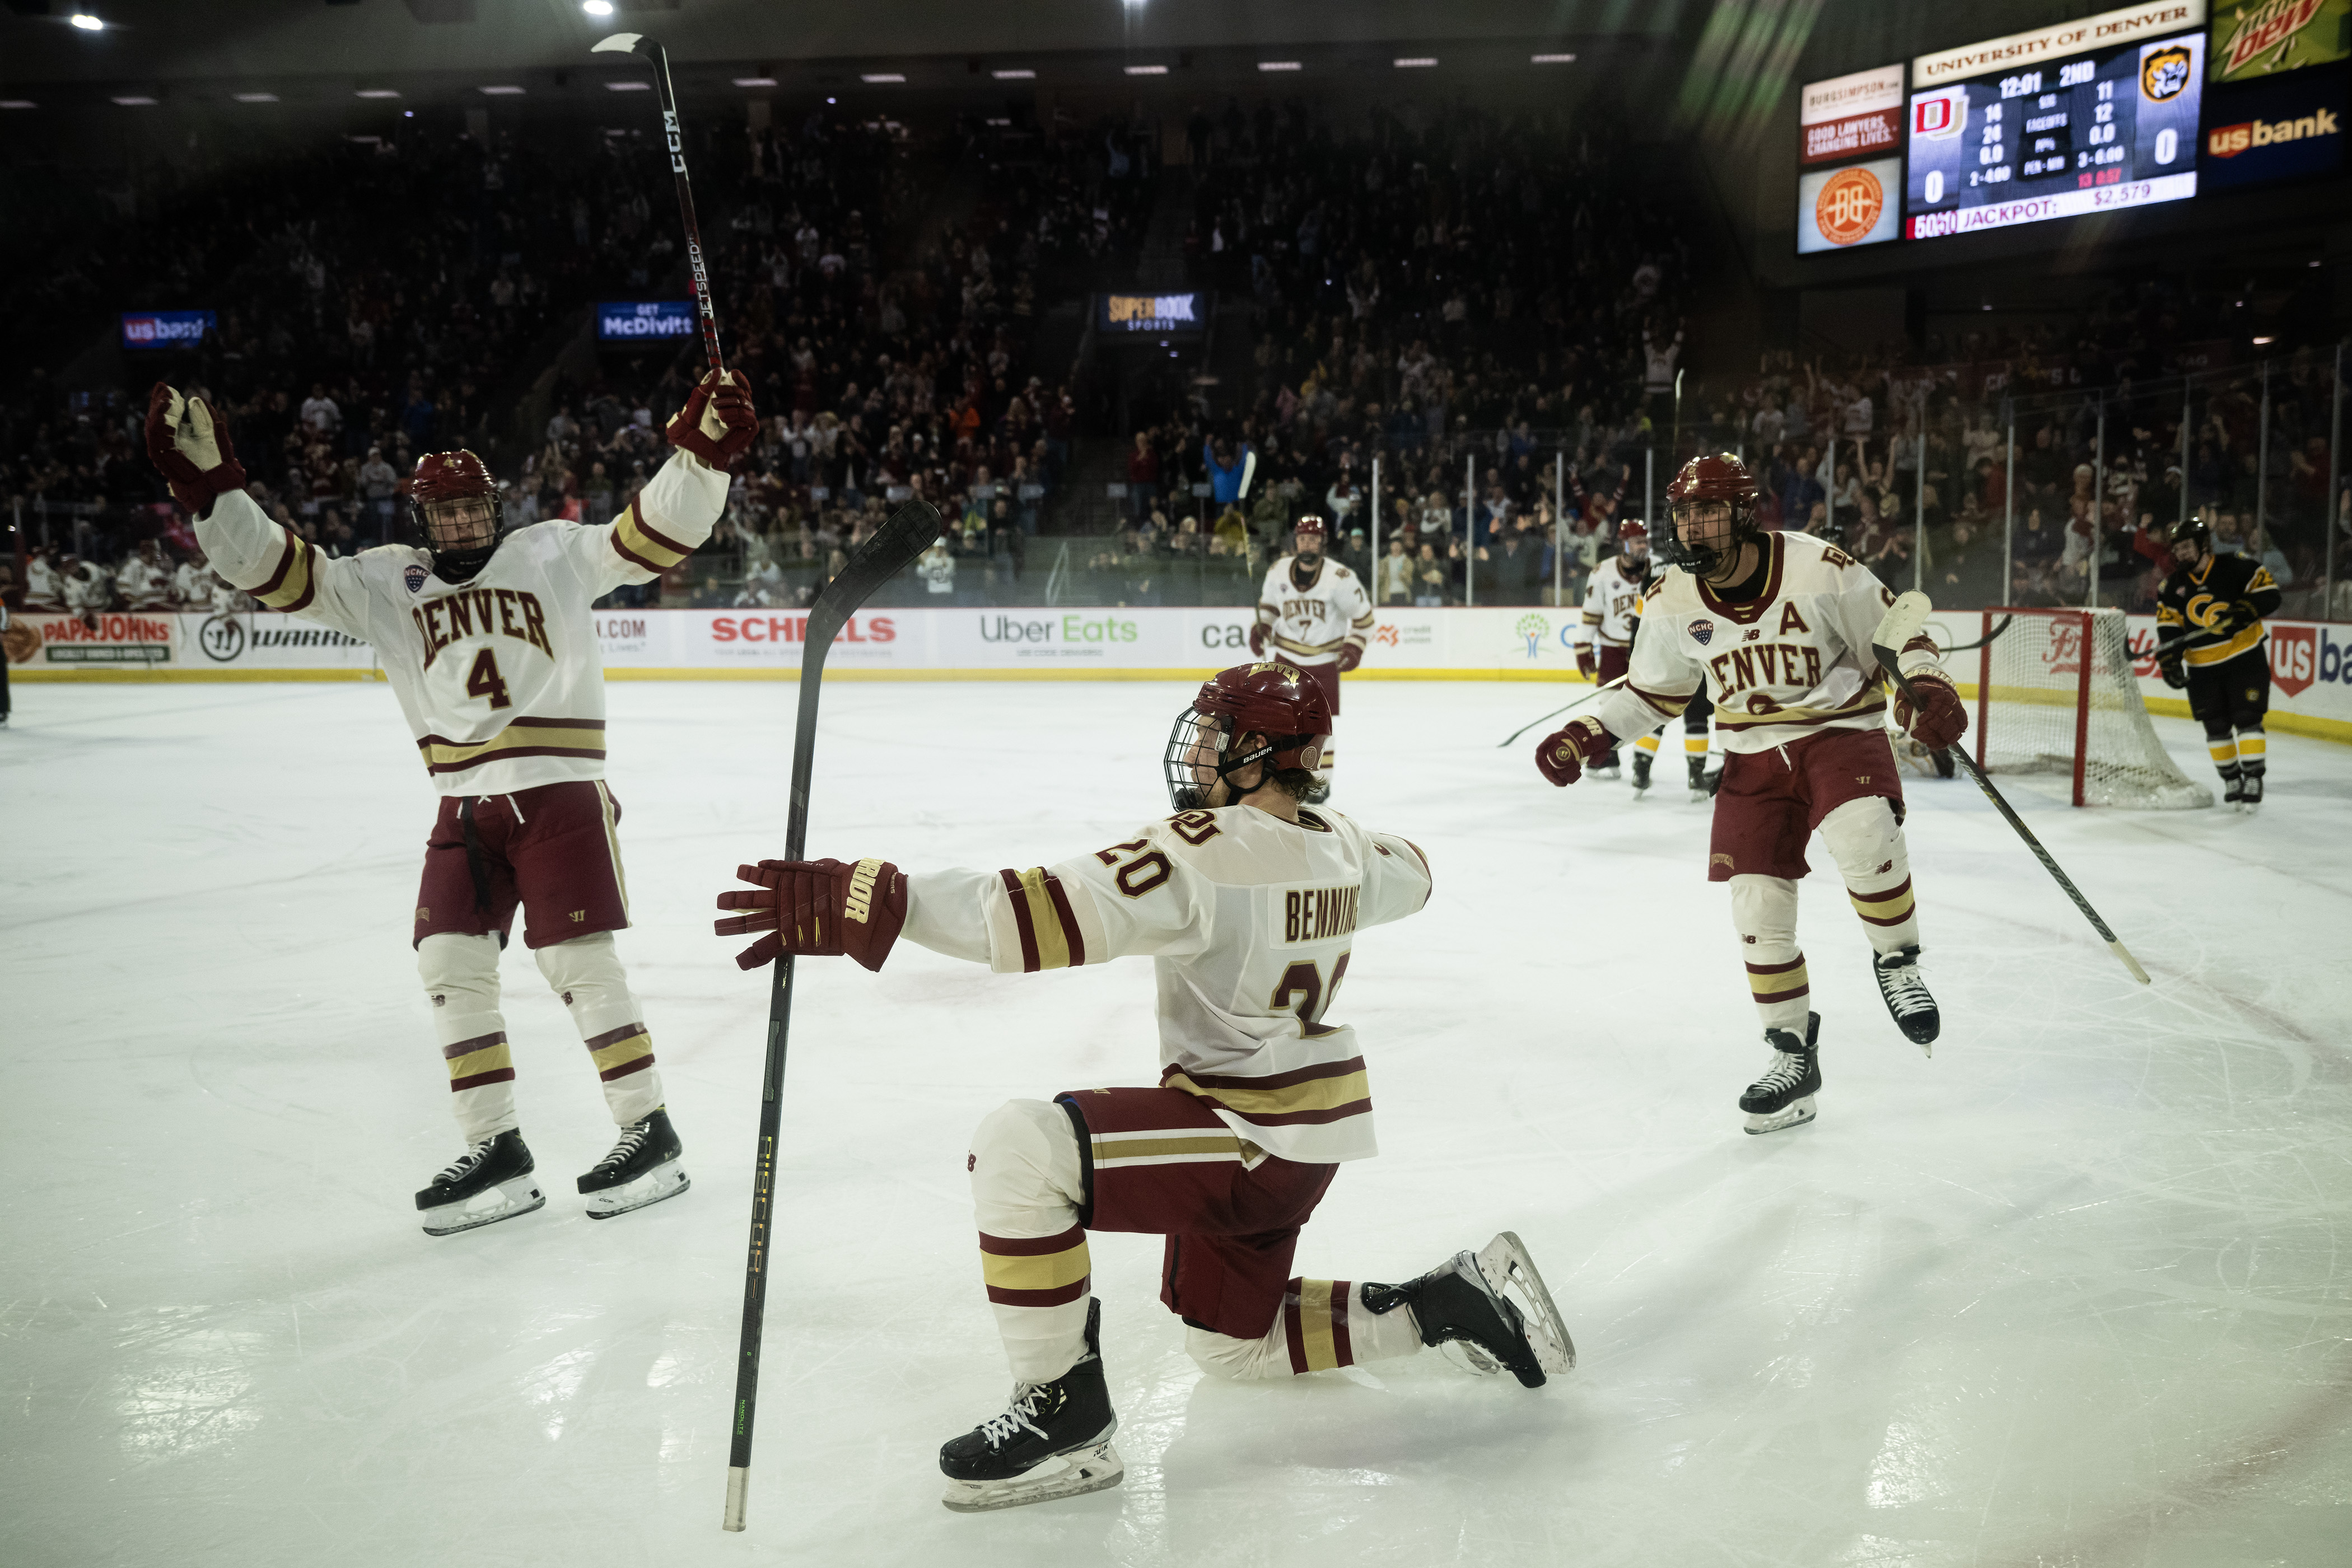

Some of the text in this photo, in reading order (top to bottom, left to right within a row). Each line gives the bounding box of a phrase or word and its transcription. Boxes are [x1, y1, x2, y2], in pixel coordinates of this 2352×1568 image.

[1926, 6, 2188, 76] UNIVERSITY OF DENVER
[1999, 60, 2095, 99] 12:01 2ND
[2097, 80, 2113, 101] 11
[2094, 102, 2113, 123] 12
[664, 111, 687, 173] CCM
[2155, 128, 2178, 165] 0
[1925, 170, 1944, 203] 0
[1964, 200, 2057, 227] JACKPOT:
[2094, 184, 2151, 206] $2,579
[689, 244, 713, 320] JETSPEED
[604, 316, 694, 335] McDivitt
[404, 567, 431, 577] NCHC
[1283, 599, 1326, 623] DENVER
[1613, 594, 1638, 617] DEN
[1779, 601, 1809, 636] A
[44, 615, 169, 641] PAPA JOHNS
[412, 588, 556, 673] DENVER
[712, 617, 897, 642] SCHLS
[981, 615, 1137, 643] Uber Eats
[1299, 620, 1312, 641] 7
[1689, 622, 1714, 633] NCHC
[465, 647, 513, 711] 4
[1247, 662, 1300, 690] DENVER
[1710, 643, 1822, 704] ENVER
[1243, 746, 1272, 763] BAUER
[1305, 749, 1314, 757] GP
[1163, 809, 1224, 847] DU
[1091, 838, 1174, 900] 20
[749, 1136, 772, 1273] RIBCOR
